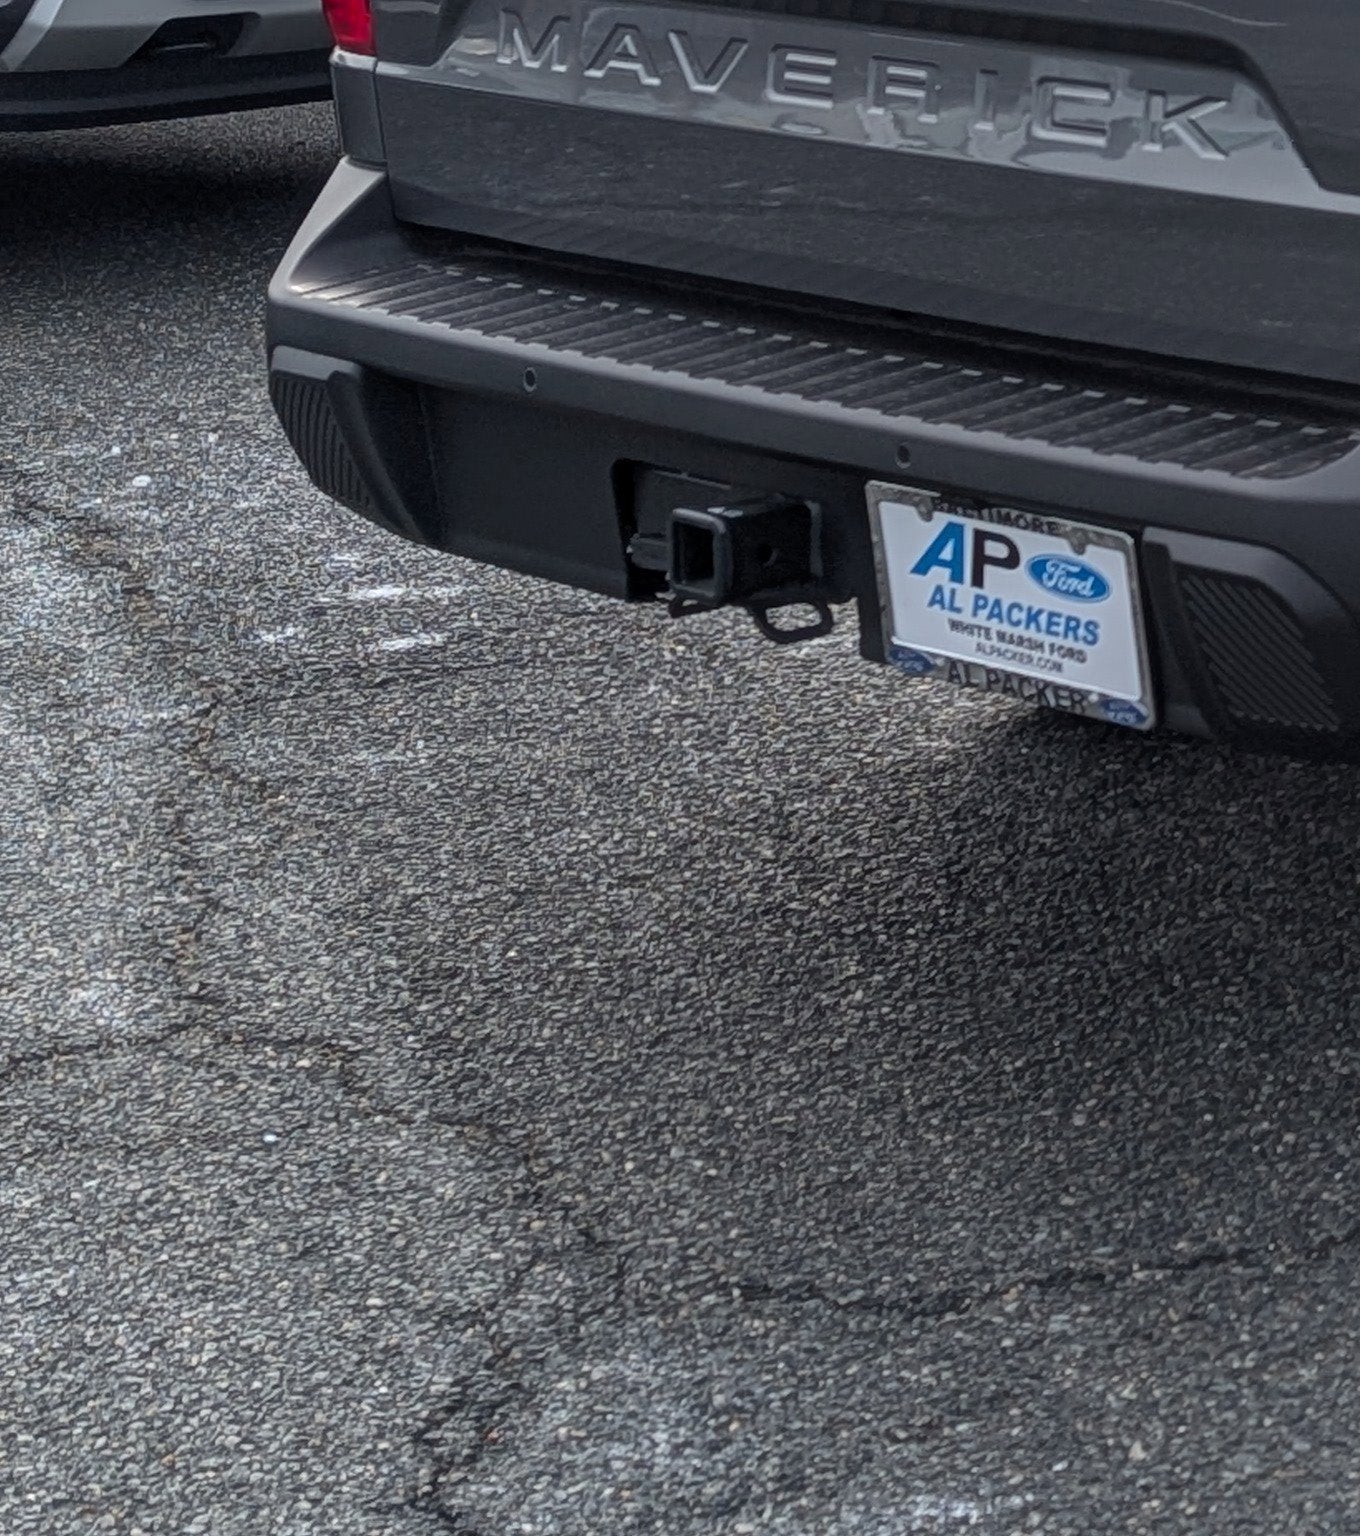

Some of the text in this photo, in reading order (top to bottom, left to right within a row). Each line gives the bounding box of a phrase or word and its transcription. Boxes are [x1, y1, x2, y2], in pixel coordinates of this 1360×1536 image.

[496, 8, 1231, 162] MAVERICK
[910, 520, 1021, 590] AP
[1043, 558, 1096, 599] Ford
[926, 584, 1100, 647] AL PACKERS
[948, 618, 1088, 664] WHITE MARSH FORD
[984, 667, 1086, 713] PACKER
